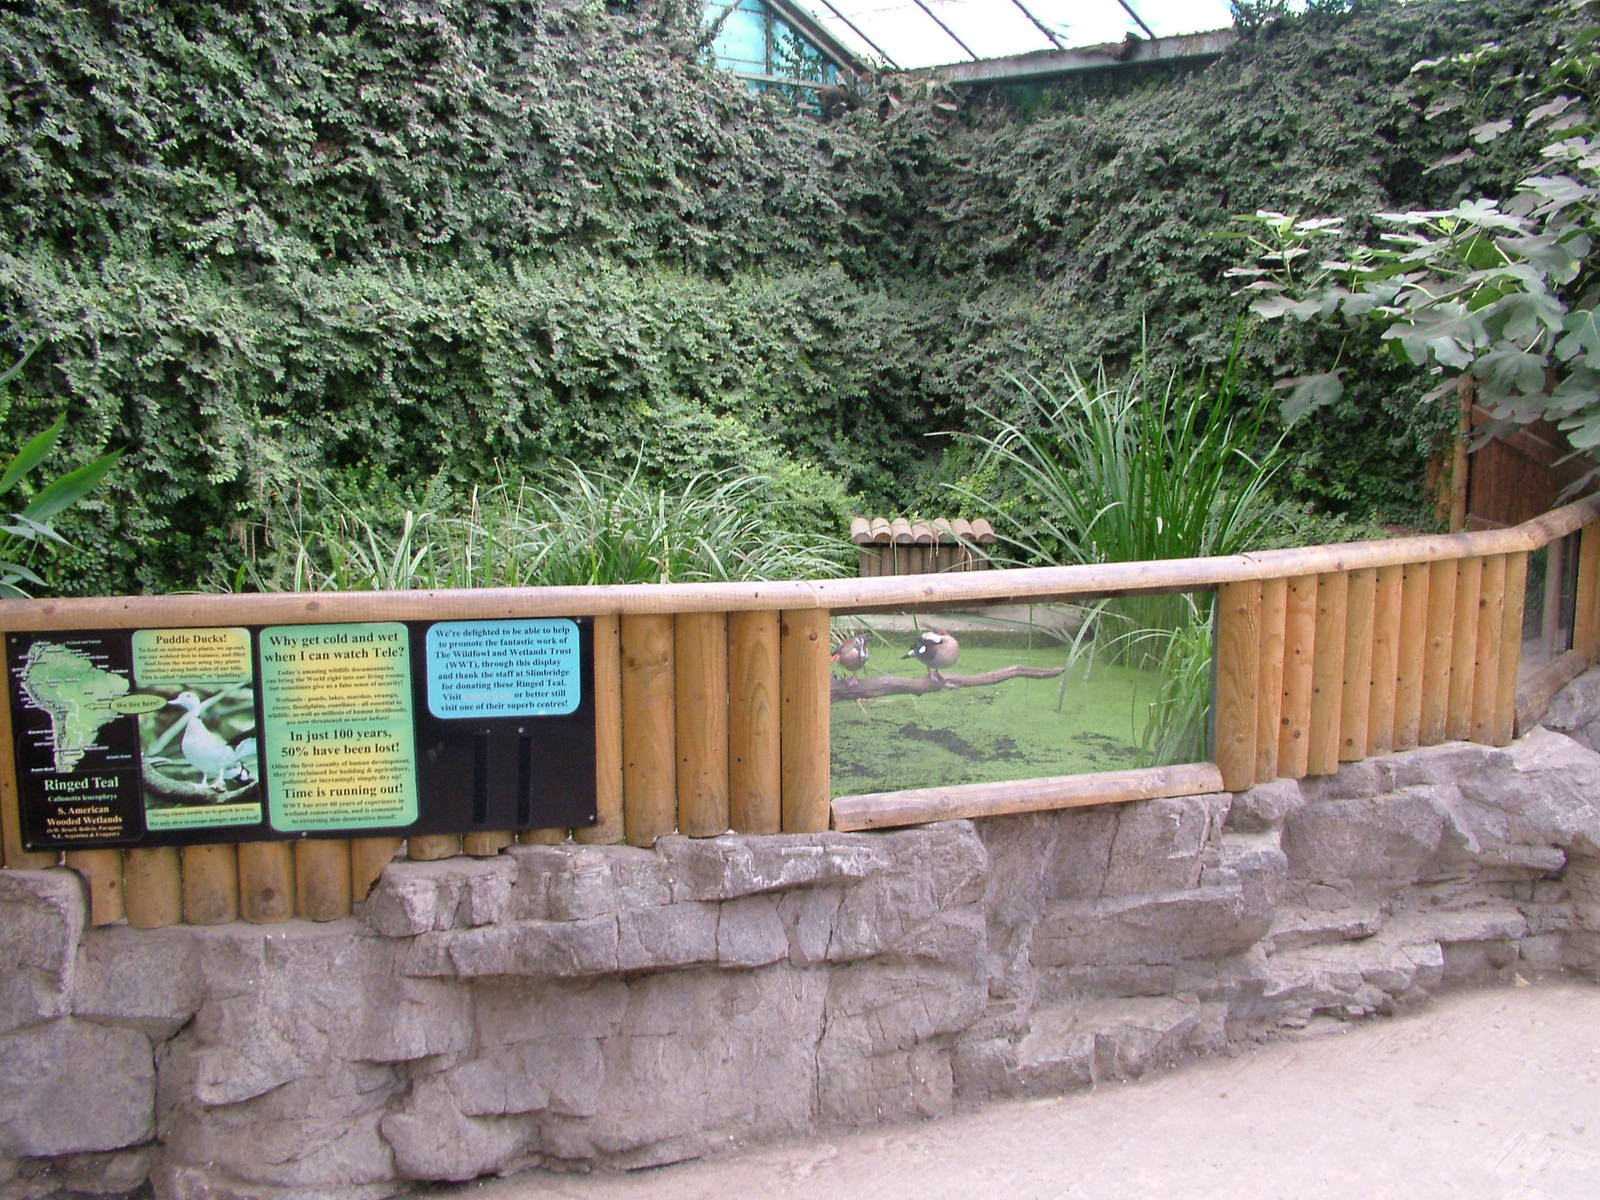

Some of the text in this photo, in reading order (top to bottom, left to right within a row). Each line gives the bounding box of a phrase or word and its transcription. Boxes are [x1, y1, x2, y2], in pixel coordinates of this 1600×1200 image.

[435, 629, 460, 637] We're
[462, 628, 500, 638] delighted
[523, 627, 541, 635] able
[552, 626, 571, 636] help
[156, 634, 228, 644] Puddle Ducks!
[269, 631, 398, 648] Why get cold and wet
[448, 639, 482, 649] promote
[499, 637, 533, 646] fantastic
[536, 637, 556, 645] work
[264, 647, 405, 662] when I can watch Tele?
[435, 647, 572, 659] The Wildfowl and Wetlands Trust
[445, 660, 480, 669] (WWT),
[481, 659, 514, 669] through
[532, 658, 561, 668] display
[437, 672, 453, 680] and
[454, 671, 478, 679] thank
[495, 670, 513, 678] staff
[525, 668, 571, 679] Slimbridge
[455, 681, 491, 691] donating
[492, 680, 514, 688] these
[515, 679, 544, 689] Ringed
[547, 678, 567, 687] Teal.
[507, 701, 534, 711] superb
[536, 700, 568, 708] centres!
[290, 729, 392, 743] In just 100 years,
[281, 743, 400, 757] 50% have been lost!
[44, 776, 119, 792] Ringed Teal
[282, 784, 404, 798] Time is running out!
[58, 805, 109, 815] S. American
[46, 815, 122, 826] Wooded Wetlands
